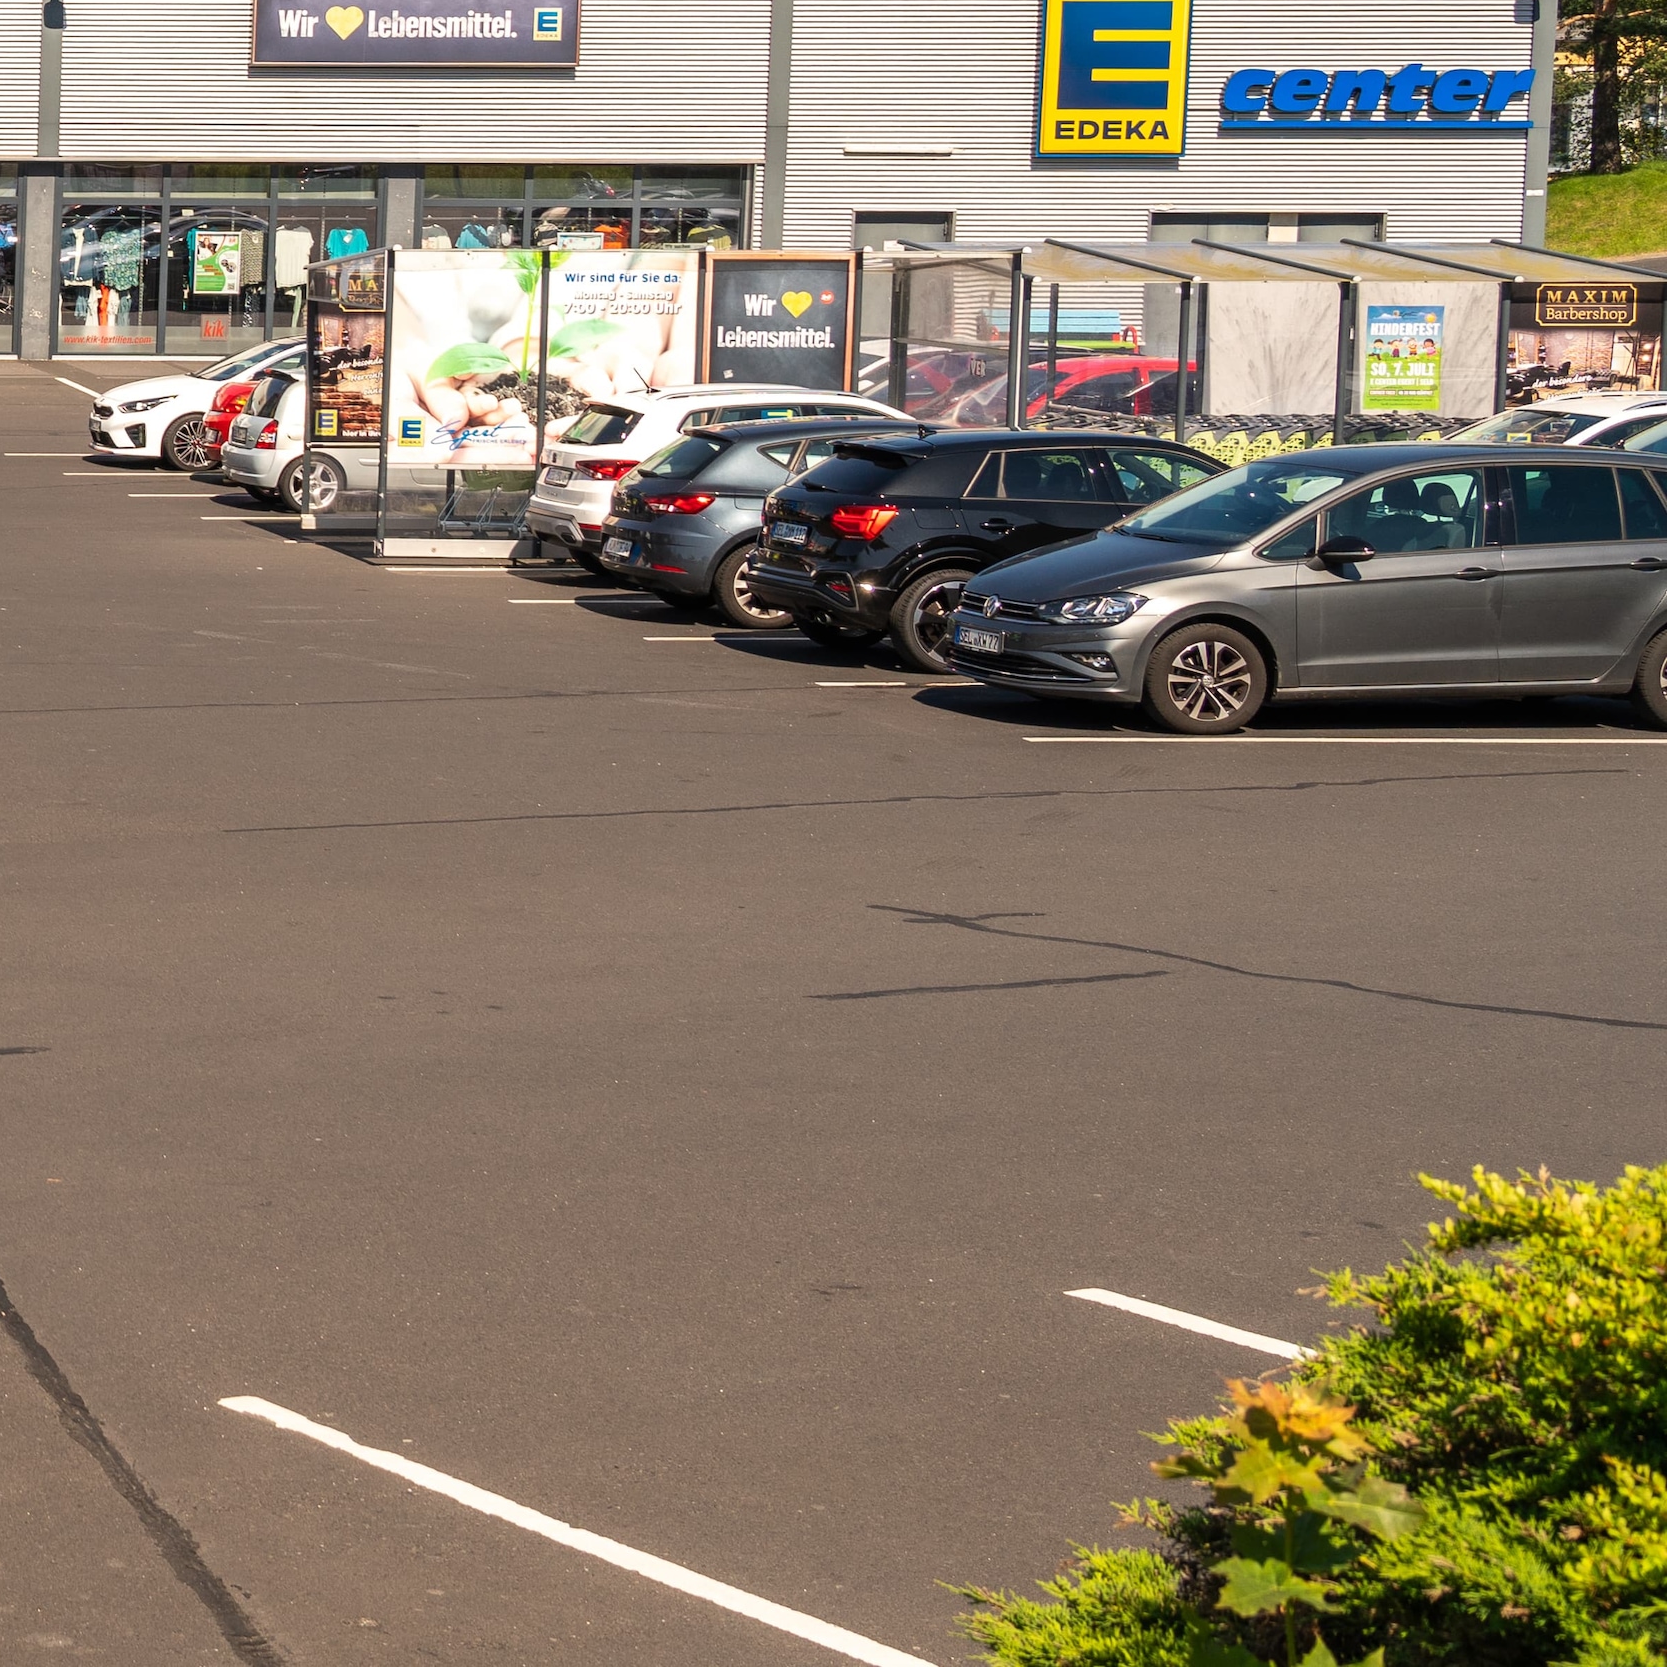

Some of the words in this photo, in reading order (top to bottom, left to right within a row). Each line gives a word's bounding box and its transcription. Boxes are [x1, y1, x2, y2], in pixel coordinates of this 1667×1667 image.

[278, 9, 319, 38] Wir
[368, 9, 518, 38] Lebensmittel.
[1222, 63, 1536, 112] center
[1055, 120, 1169, 140] EDEKA
[565, 273, 586, 283] Wir
[590, 272, 615, 283] sind
[619, 272, 638, 283] für
[642, 272, 660, 283] Sie
[664, 272, 682, 283] da:
[574, 291, 617, 302] Montag
[626, 291, 674, 302] Samstag
[1546, 290, 1628, 304] MAXIM
[564, 302, 597, 315] 7:00
[610, 302, 652, 315] 20:00
[656, 302, 683, 315] Uhr
[744, 294, 777, 317] Wir
[1545, 307, 1628, 323] Barbershop
[203, 319, 225, 338] kik
[1370, 322, 1441, 336] KINDERFEST
[63, 335, 153, 345] www.kik-textilien.com
[717, 325, 836, 349] Lebensmittel.
[1370, 362, 1391, 378] SO,
[1406, 362, 1436, 377] JULI
